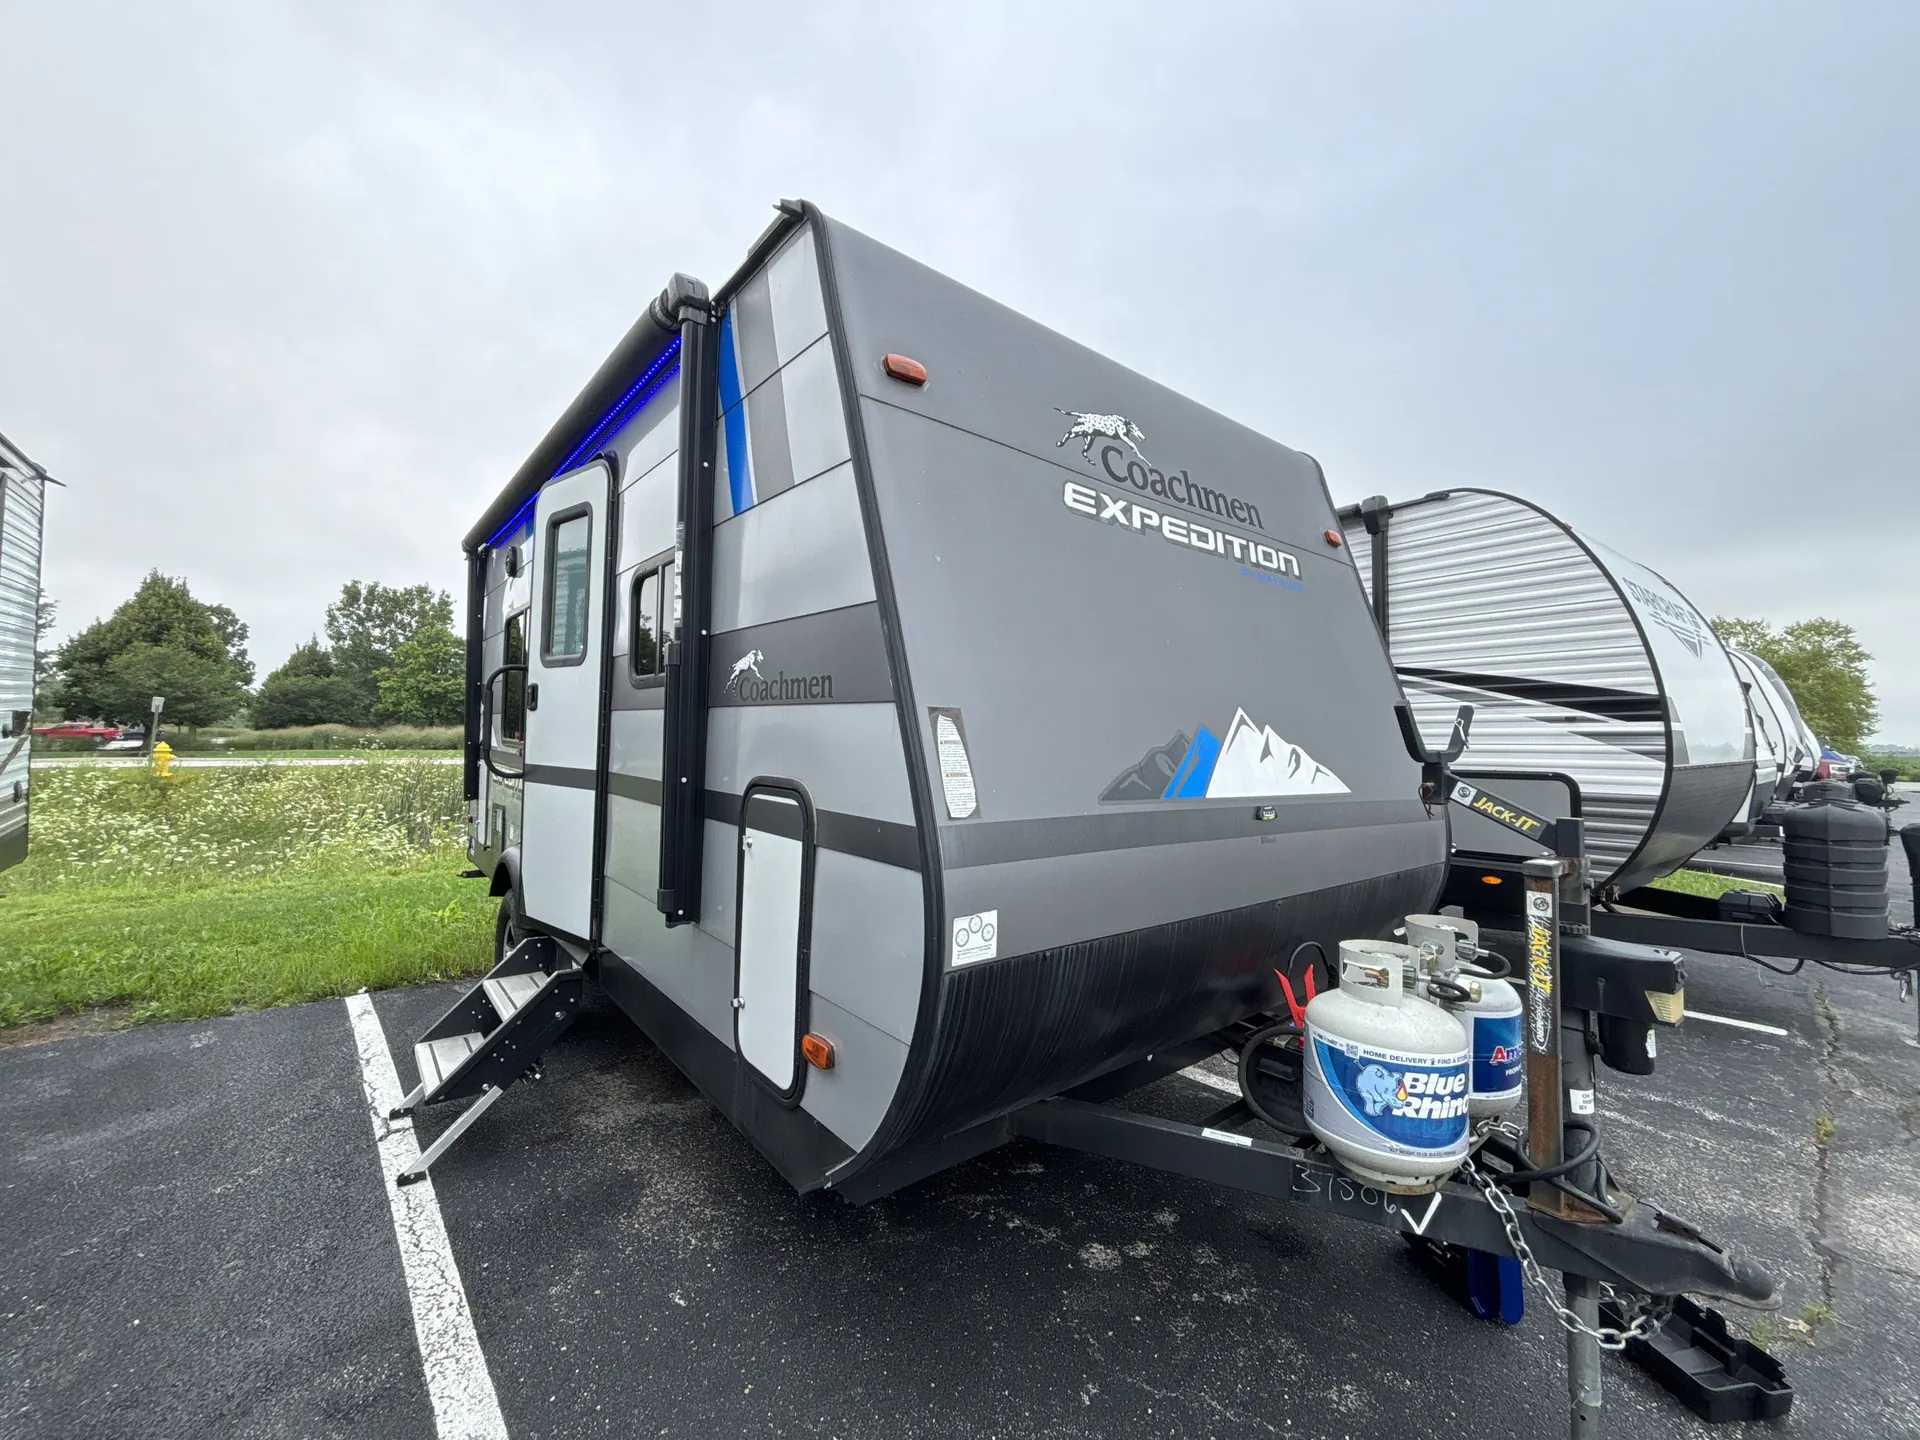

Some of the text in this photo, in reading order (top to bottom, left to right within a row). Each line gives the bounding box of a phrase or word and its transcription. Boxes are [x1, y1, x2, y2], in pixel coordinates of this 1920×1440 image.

[1100, 445, 1264, 529] Coachmen
[1064, 480, 1301, 578] EXPEDITION
[740, 671, 833, 702] Coachmen
[1473, 796, 1541, 831] JACK-IT
[1530, 922, 1551, 998] JACK-IT
[1363, 1049, 1387, 1060] HOME
[1389, 1054, 1428, 1065] DELIVERY
[1403, 1072, 1466, 1095] Blue
